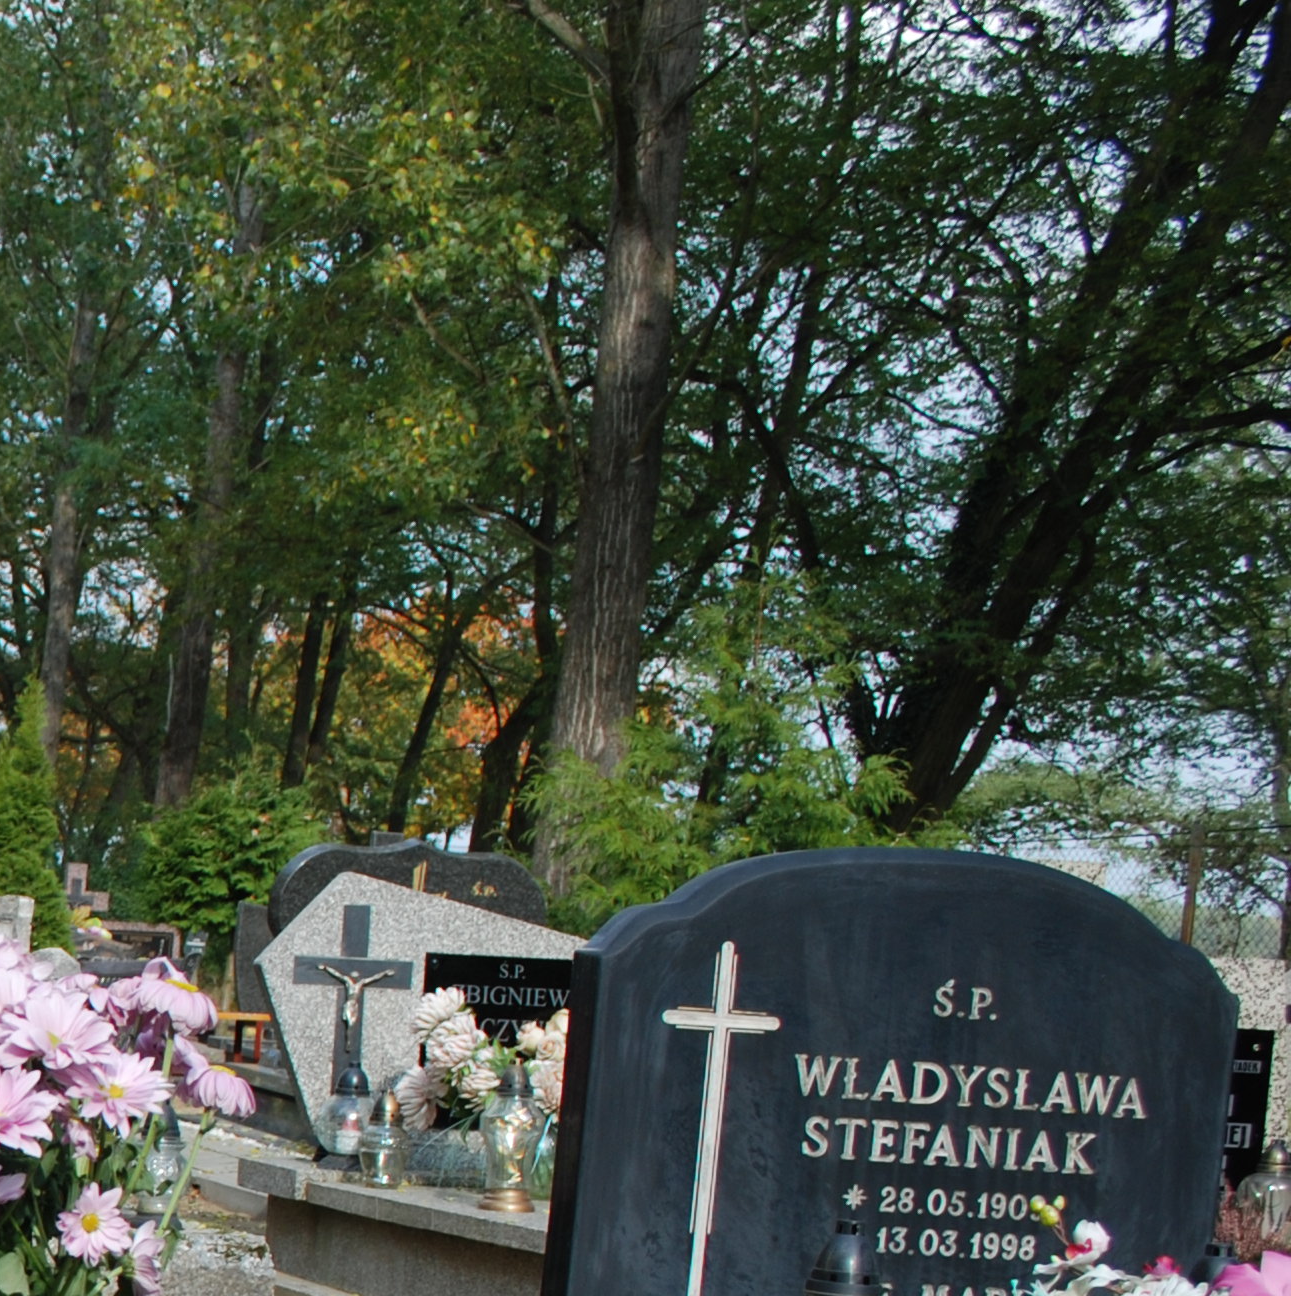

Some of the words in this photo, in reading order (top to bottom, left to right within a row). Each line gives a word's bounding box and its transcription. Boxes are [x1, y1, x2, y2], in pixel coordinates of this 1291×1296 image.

[499, 960, 526, 979] Ś.P.
[933, 979, 998, 1021] Ś.P.
[795, 1053, 1148, 1120] WŁADYSŁAWA
[801, 1116, 1097, 1175] STEFANIAK
[879, 1186, 1041, 1221] 28.05.190
[876, 1226, 1037, 1261] 13.03.1998
